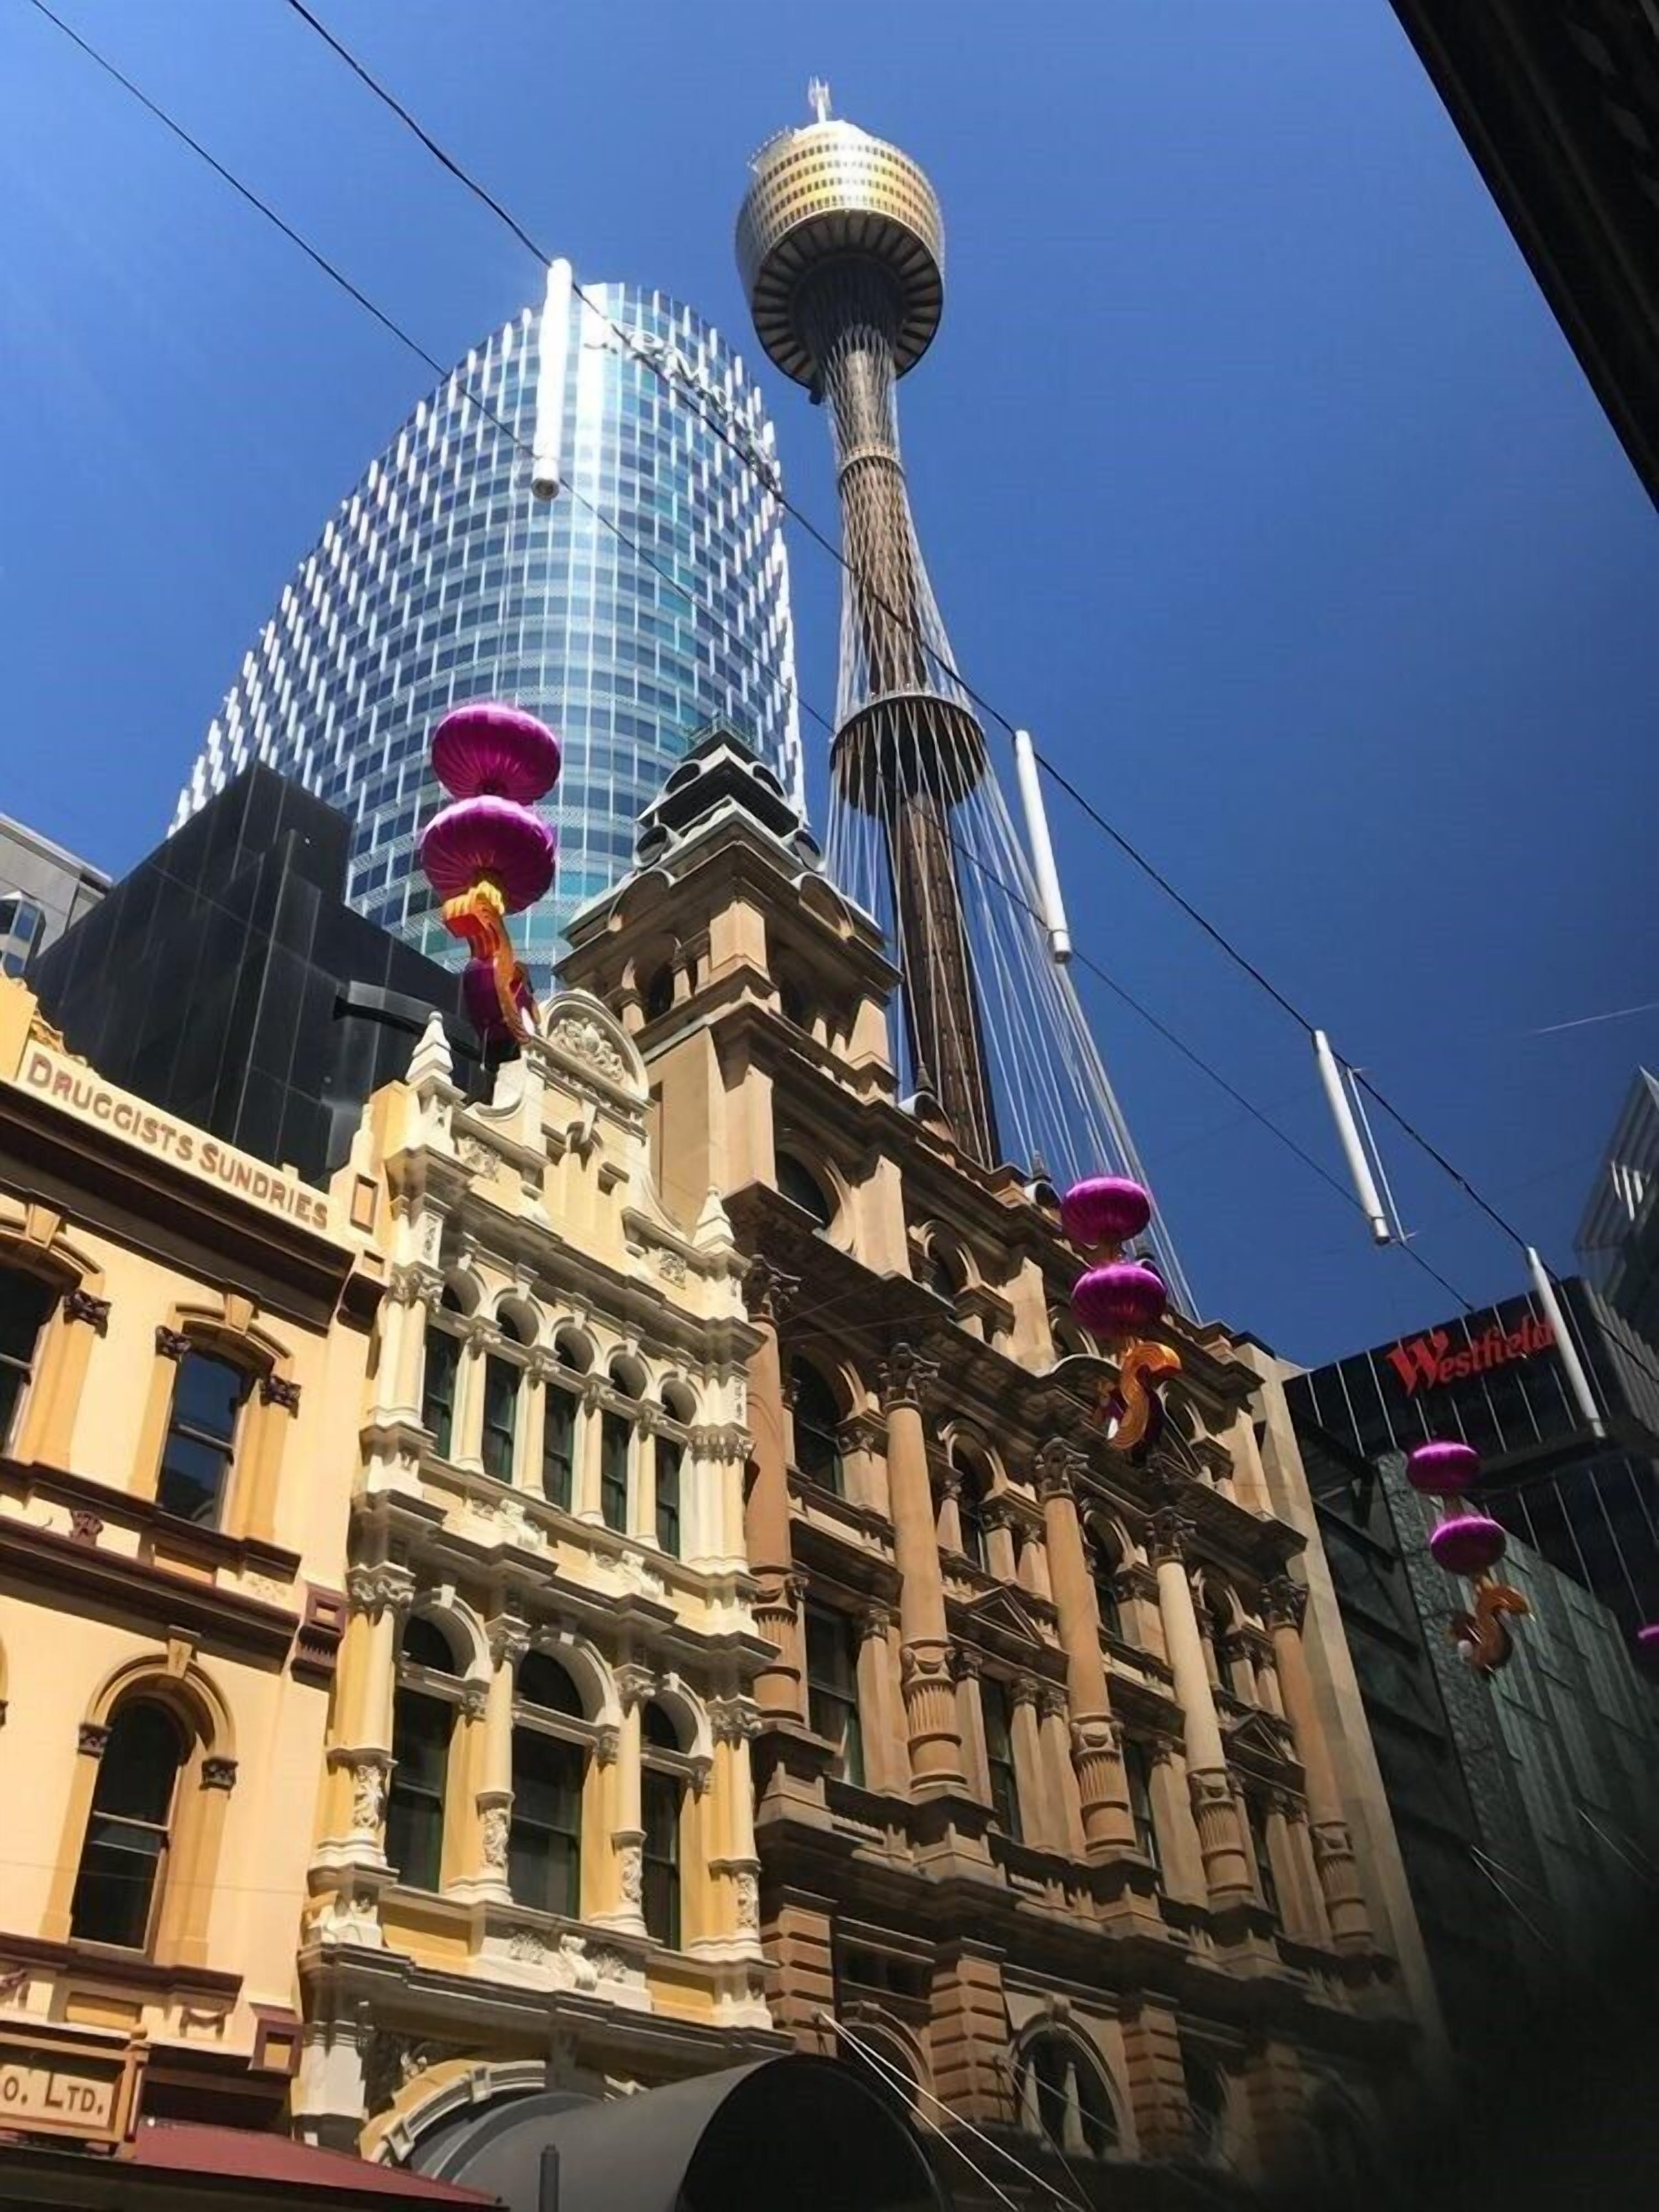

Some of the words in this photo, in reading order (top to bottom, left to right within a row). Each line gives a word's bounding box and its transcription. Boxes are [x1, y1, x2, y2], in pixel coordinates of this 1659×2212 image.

[27, 1051, 194, 1161] DRUGGISTS
[200, 1142, 327, 1230] SUNDRIES
[44, 2072, 103, 2115] LTD.
